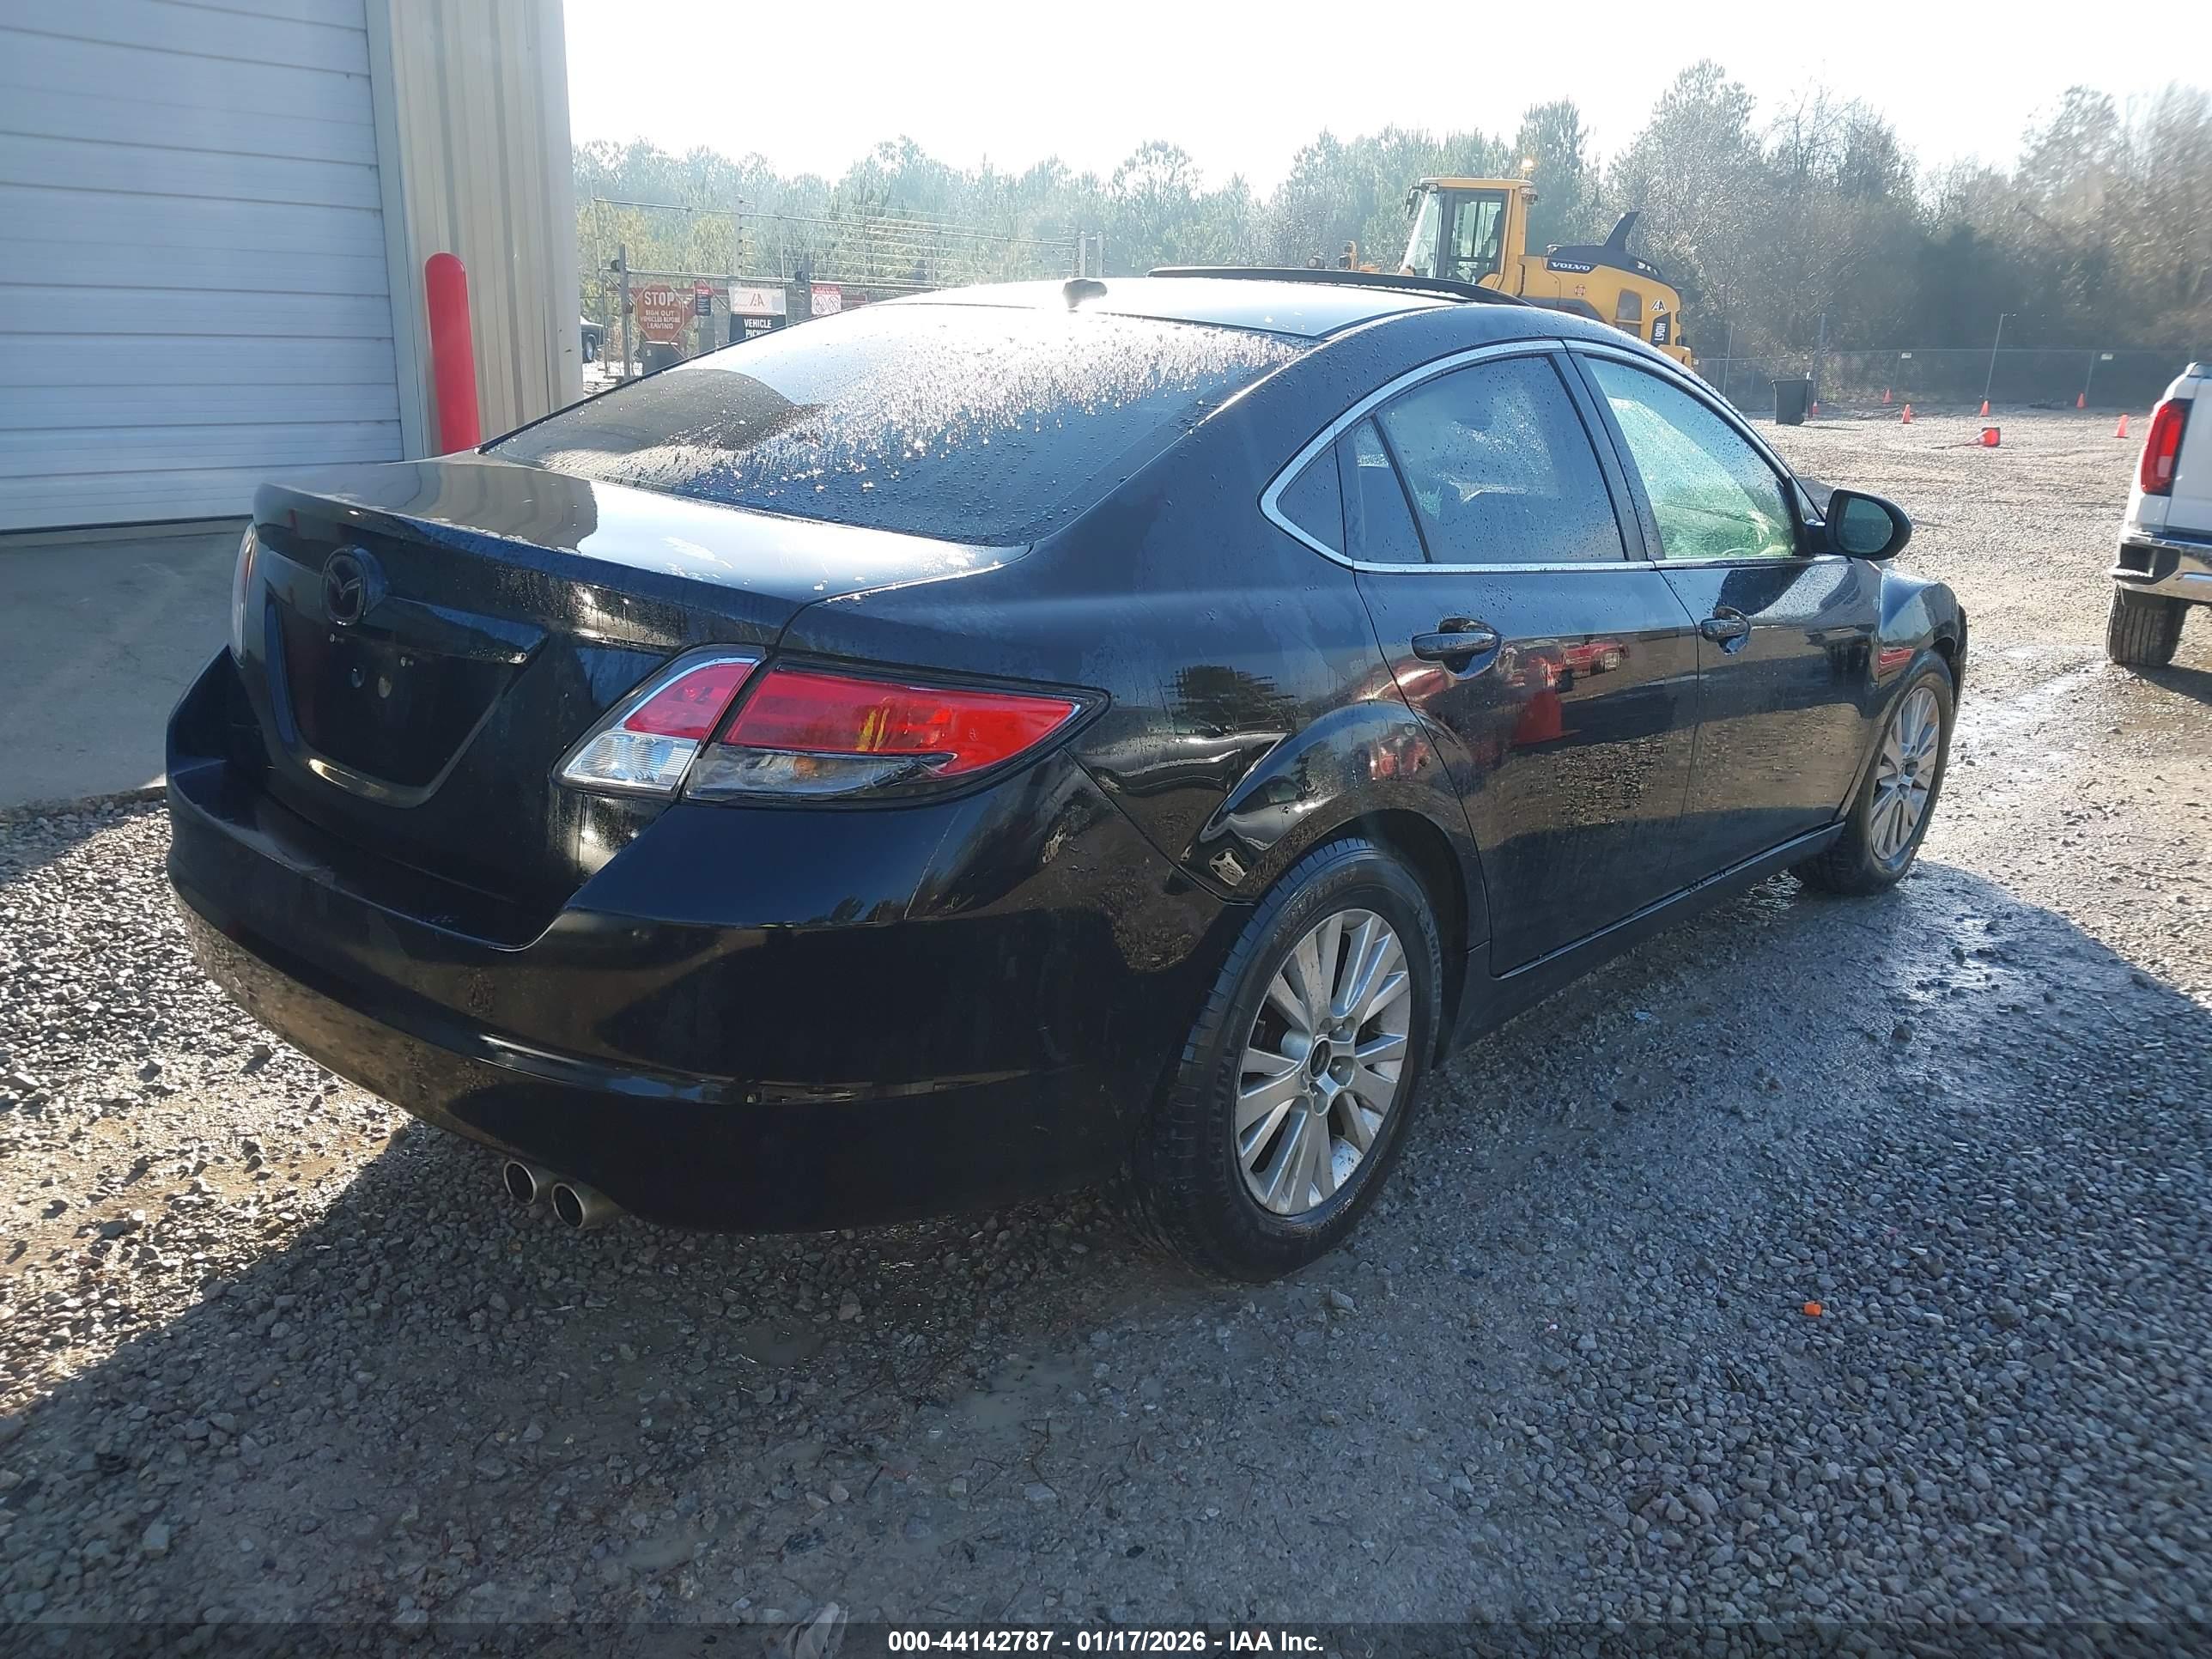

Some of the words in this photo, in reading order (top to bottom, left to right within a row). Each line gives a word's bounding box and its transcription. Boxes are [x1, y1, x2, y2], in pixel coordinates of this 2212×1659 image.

[1551, 261, 1590, 271] VOLVO
[644, 291, 674, 307] STOP
[744, 319, 772, 329] VEHICLE
[745, 329, 769, 339] PICK
[1654, 322, 1667, 342] L90H
